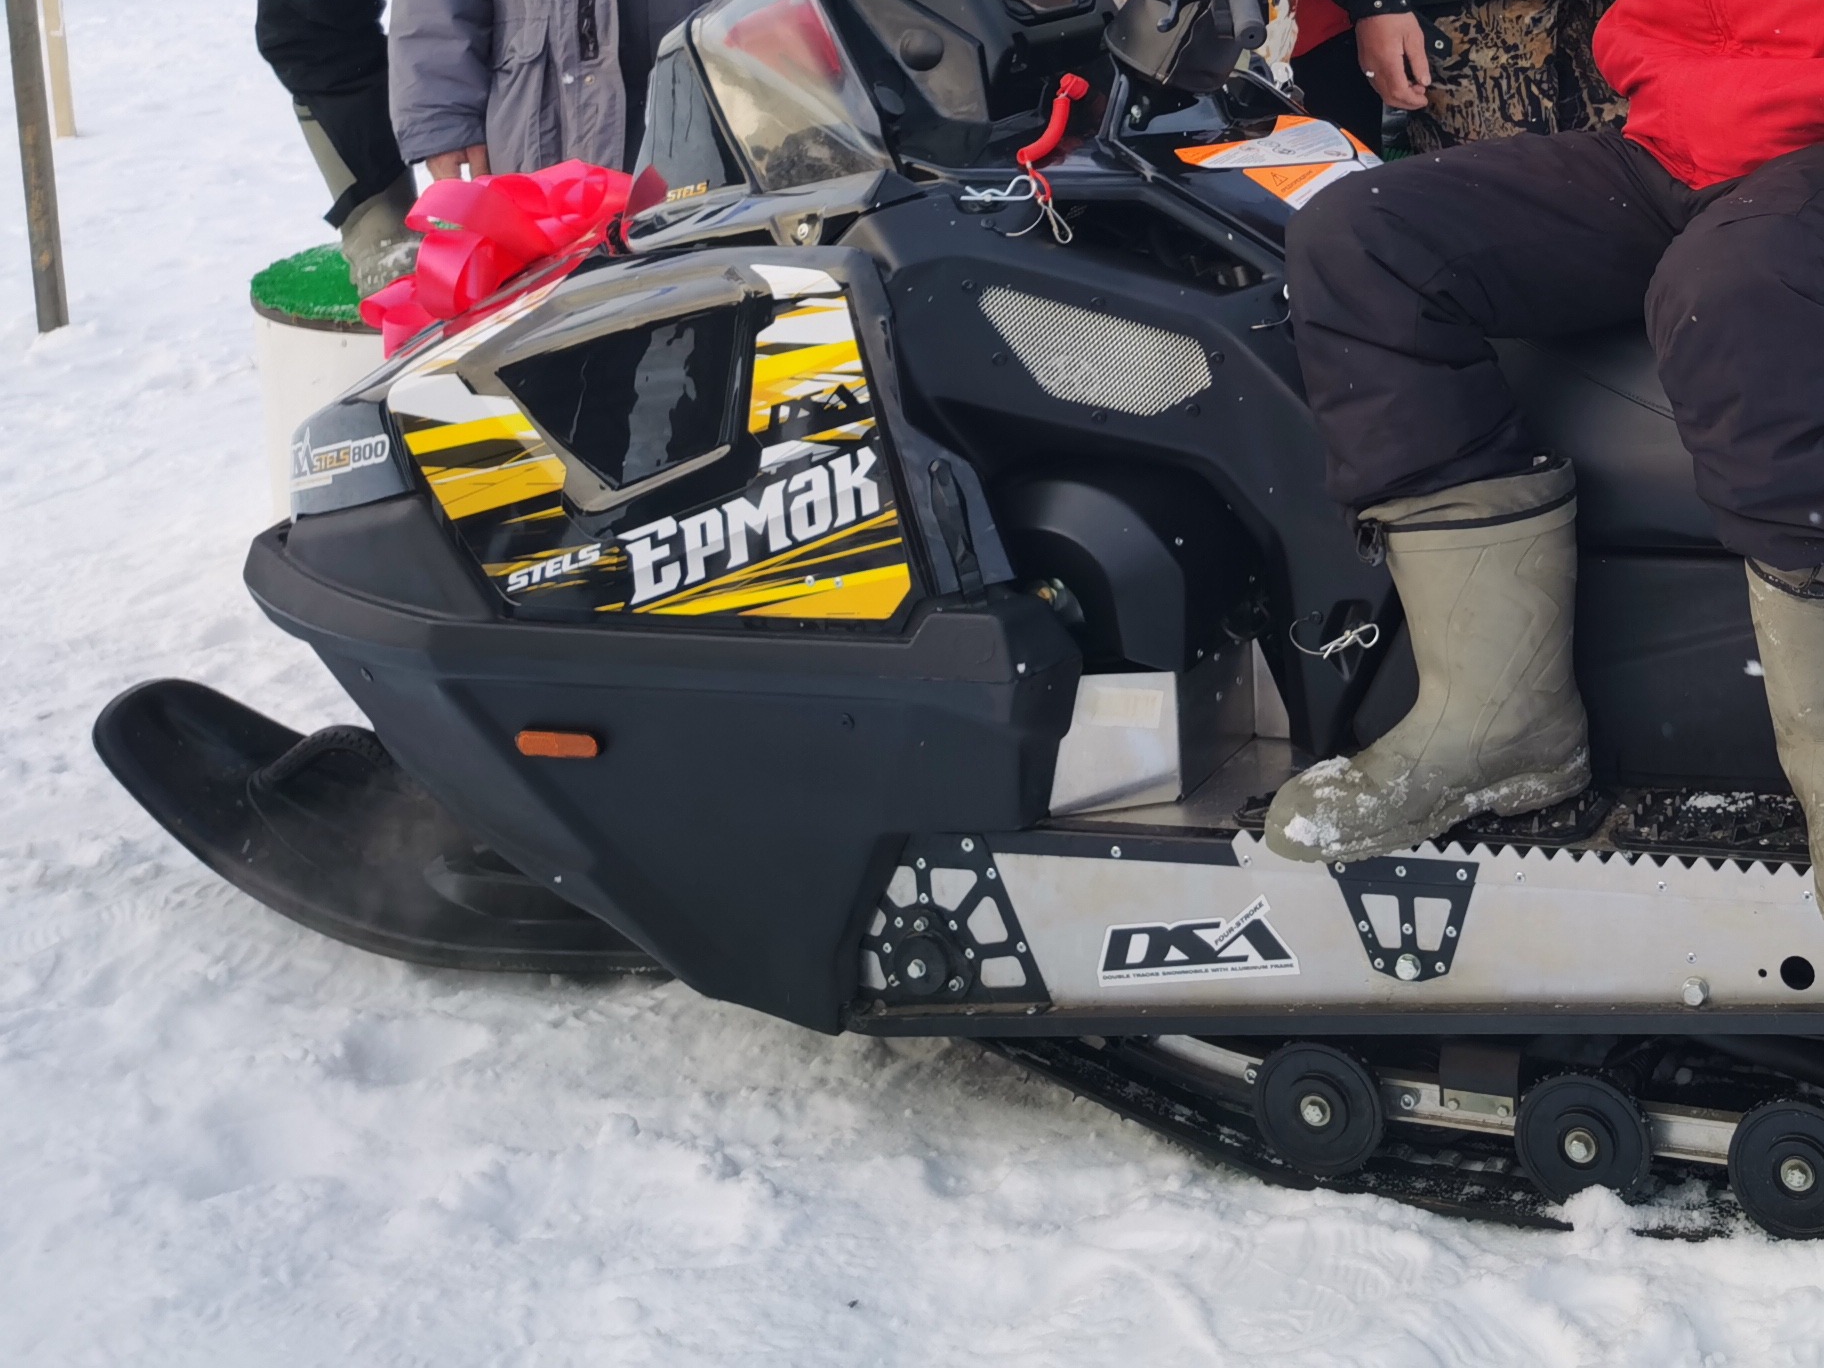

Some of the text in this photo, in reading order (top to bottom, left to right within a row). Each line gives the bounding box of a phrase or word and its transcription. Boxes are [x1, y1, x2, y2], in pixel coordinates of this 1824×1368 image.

[352, 440, 387, 464] 800
[506, 542, 602, 593] STELS
[1214, 900, 1264, 947] FOUR-STROKE
[1162, 968, 1209, 976] SNOWMOBILE
